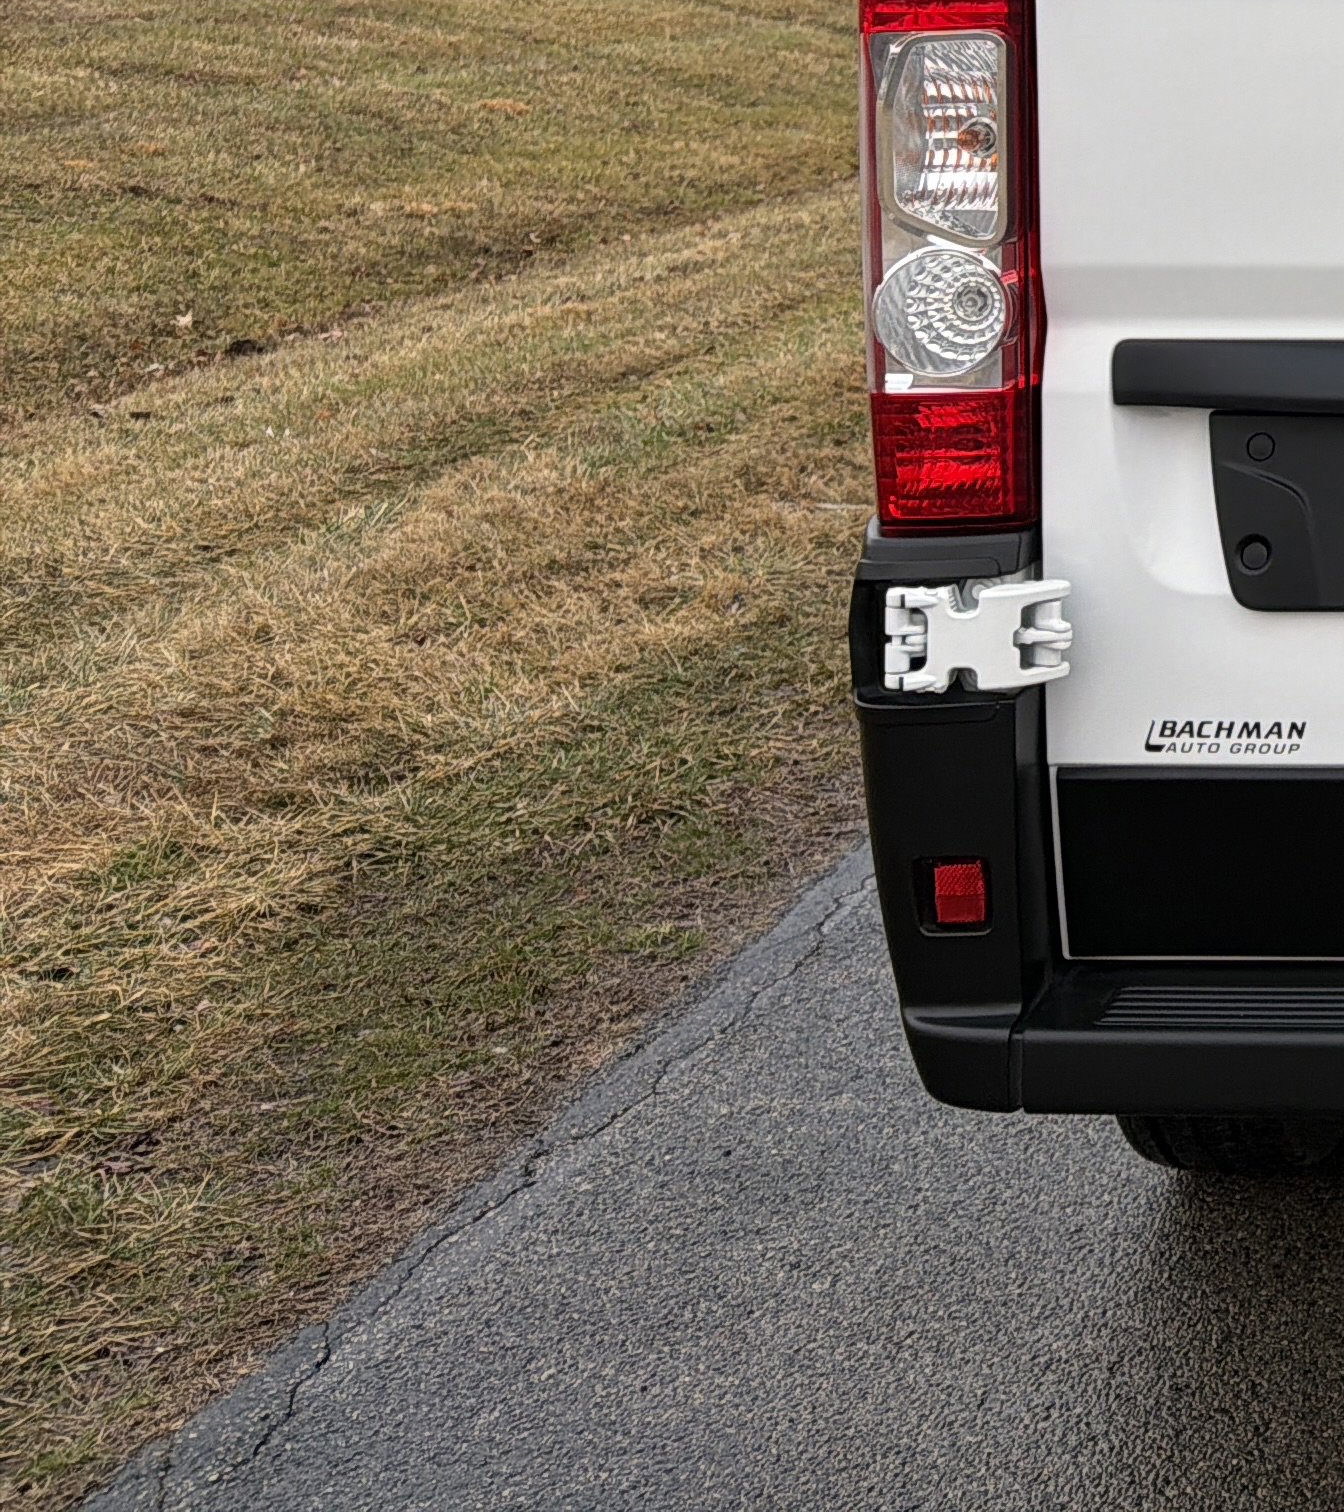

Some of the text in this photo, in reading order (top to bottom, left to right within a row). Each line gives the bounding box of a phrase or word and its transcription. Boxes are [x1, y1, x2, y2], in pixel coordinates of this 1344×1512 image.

[1158, 720, 1307, 740] BACHMAN
[1164, 742, 1301, 755] AUTO GROUP
